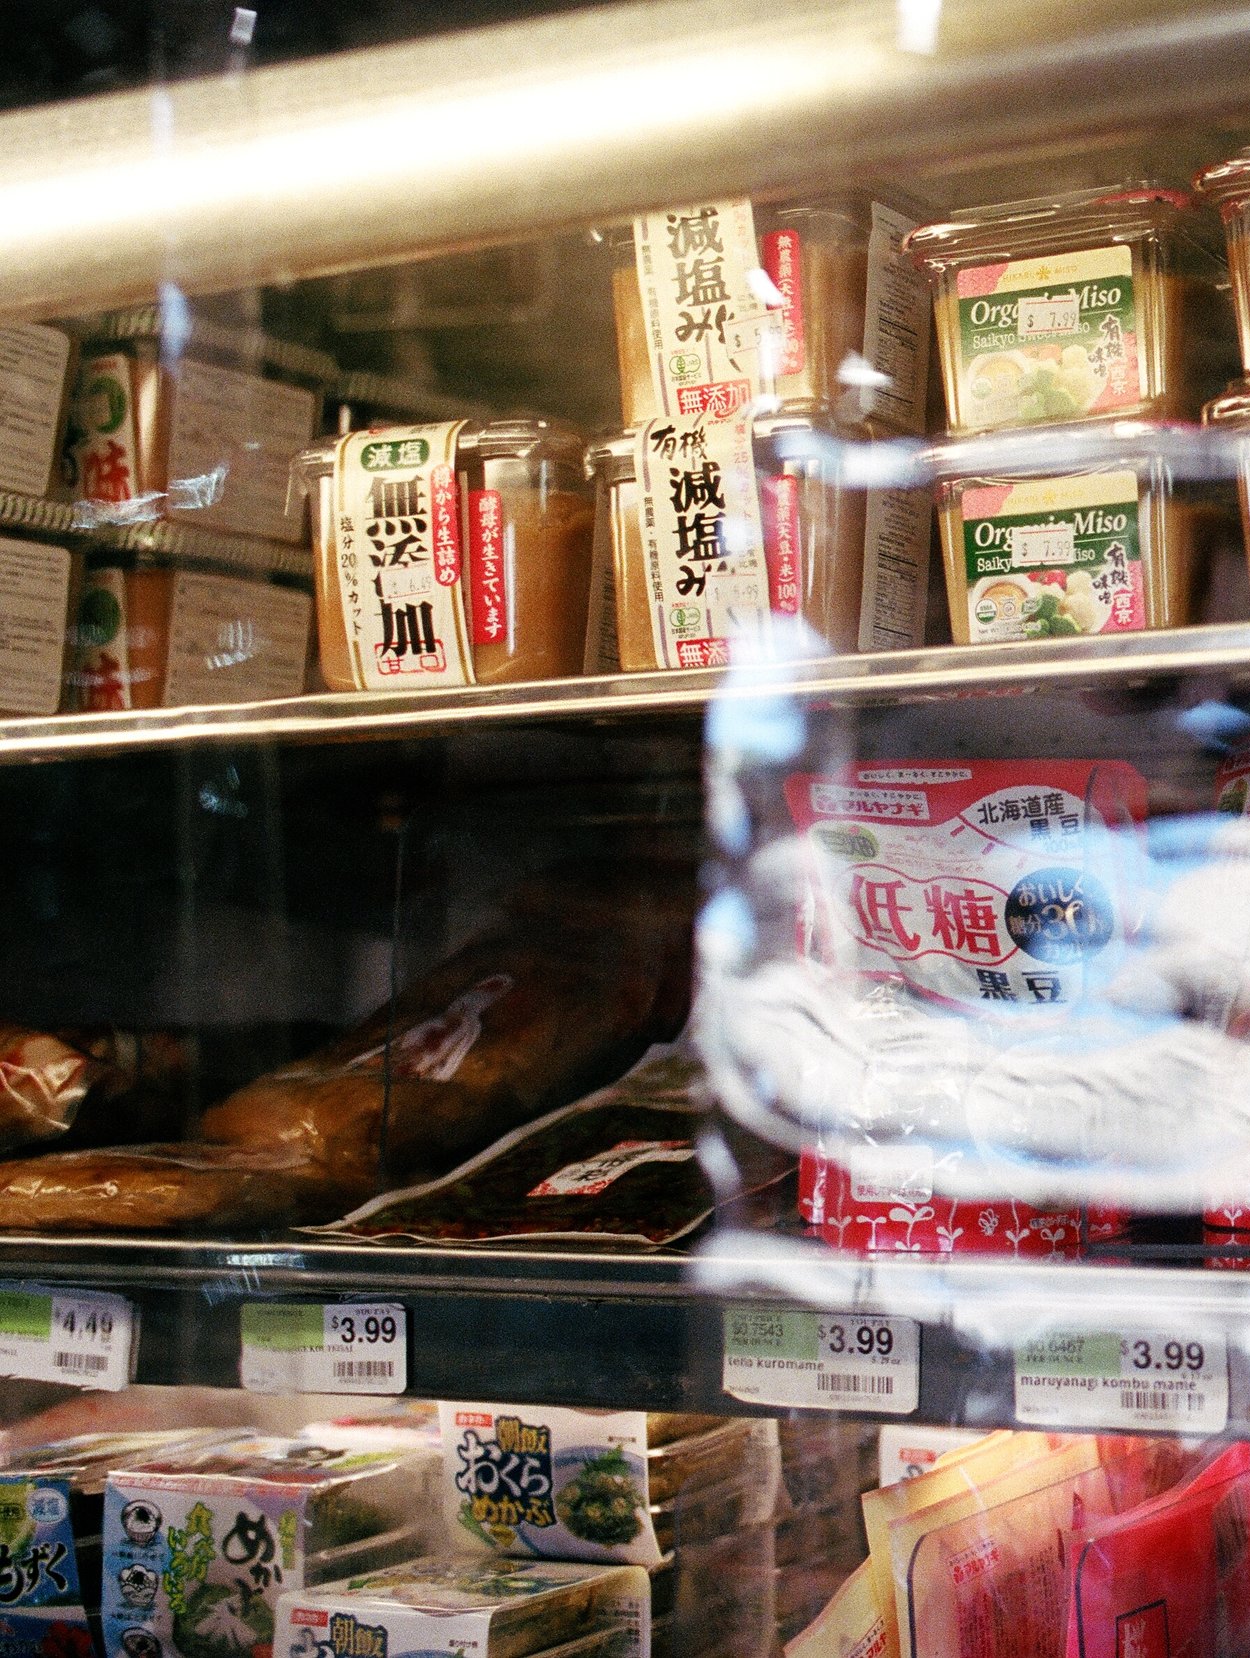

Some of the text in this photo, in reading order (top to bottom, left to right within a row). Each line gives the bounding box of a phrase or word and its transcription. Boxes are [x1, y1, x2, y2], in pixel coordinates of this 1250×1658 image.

[1072, 284, 1122, 311] Miso
[1050, 311, 1078, 328] 7.99
[972, 331, 1016, 350] Saikyo
[679, 381, 750, 414] 無添加
[367, 441, 424, 468] 減塩
[651, 424, 708, 461] 有機
[1073, 510, 1128, 536] Miso
[478, 495, 503, 639] 酵母が生きています
[976, 555, 1013, 574] Saiky
[1113, 591, 1134, 625] 西京
[976, 792, 1066, 826] 北海道産
[853, 875, 1002, 957] 低糖
[975, 967, 1068, 1006] 黒豆
[330, 1314, 398, 1344] $3.99
[817, 1323, 894, 1356] $3.99
[756, 1357, 825, 1371] kuromame
[1119, 1339, 1205, 1371] $3.99
[1020, 1375, 1099, 1392] maruyanagi
[1101, 1376, 1149, 1390] kombu
[456, 1430, 553, 1497] おくら
